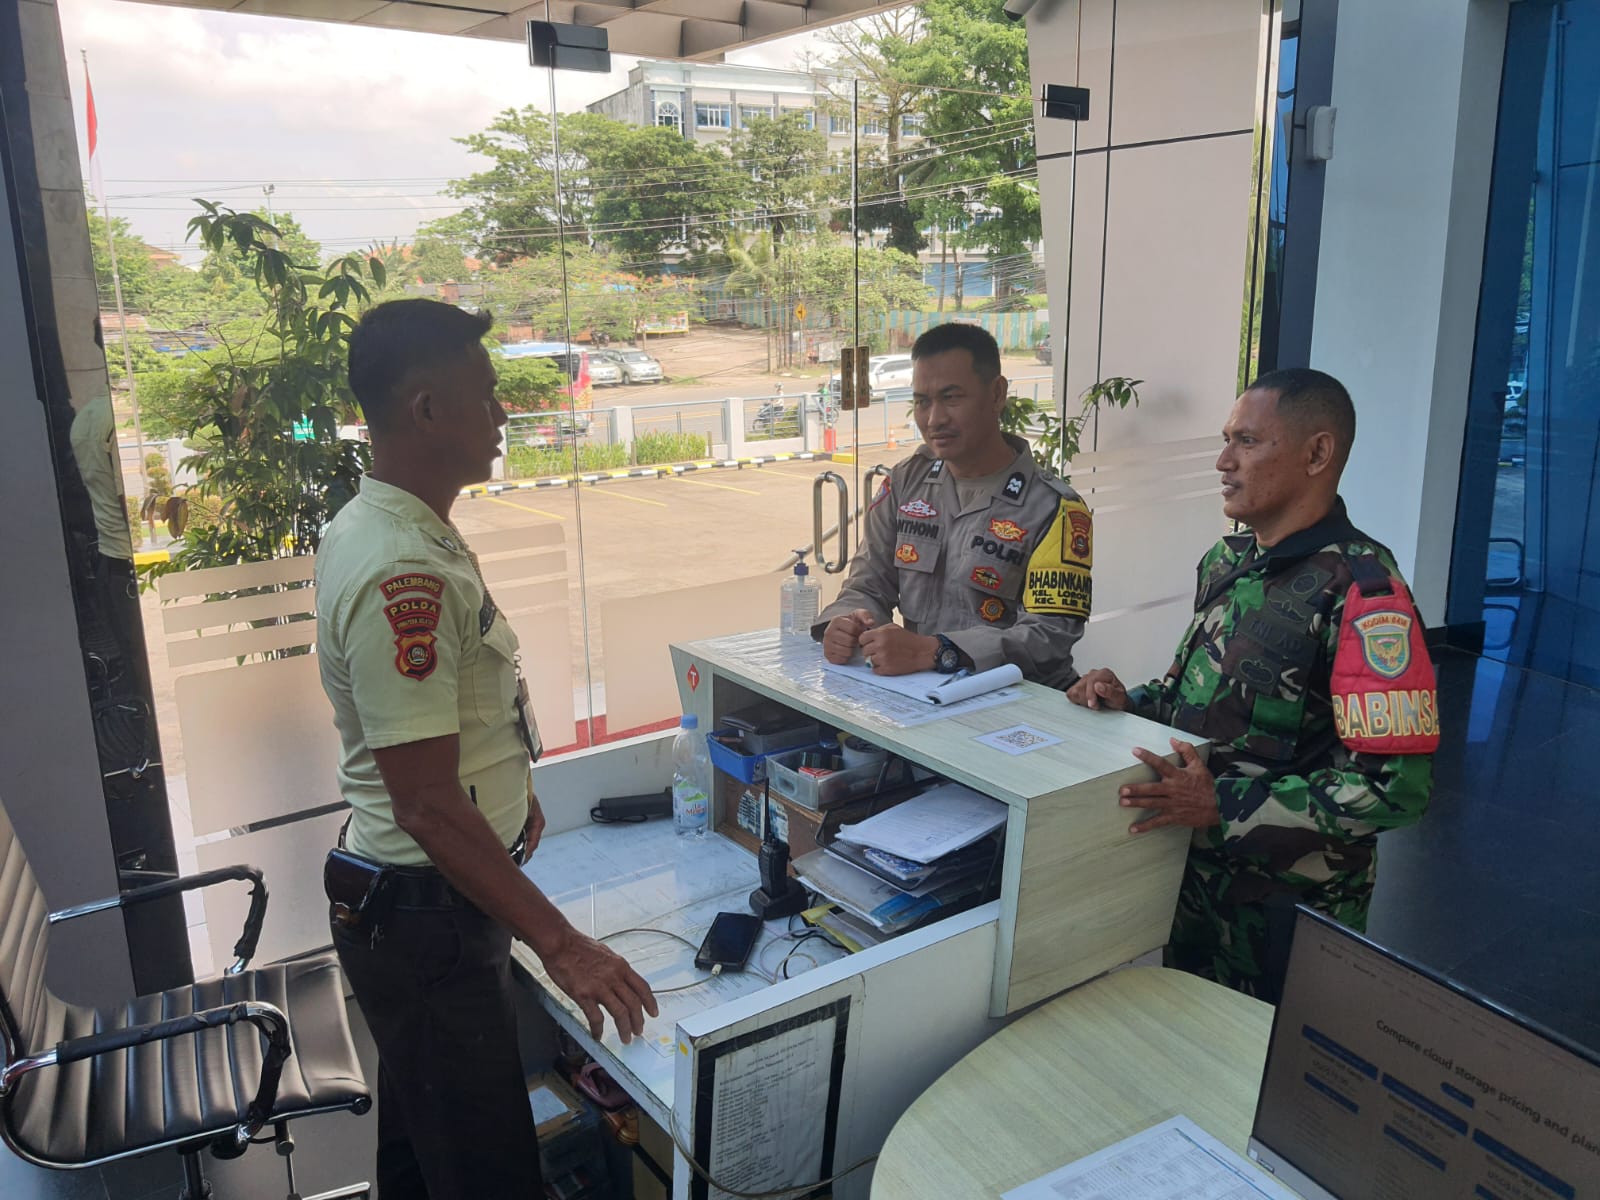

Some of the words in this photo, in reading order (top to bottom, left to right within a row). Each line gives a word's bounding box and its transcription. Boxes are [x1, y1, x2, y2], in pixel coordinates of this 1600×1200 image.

[896, 519, 939, 539] NTHONI
[971, 536, 1025, 566] POLRI
[385, 577, 440, 593] PALEMBANG
[389, 601, 437, 617] POLDA
[1376, 1019, 1422, 1052] Compare
[1422, 1047, 1454, 1071] cloud
[1455, 1065, 1496, 1095] storage
[1498, 1091, 1541, 1123] pricing
[1543, 1117, 1570, 1138] and
